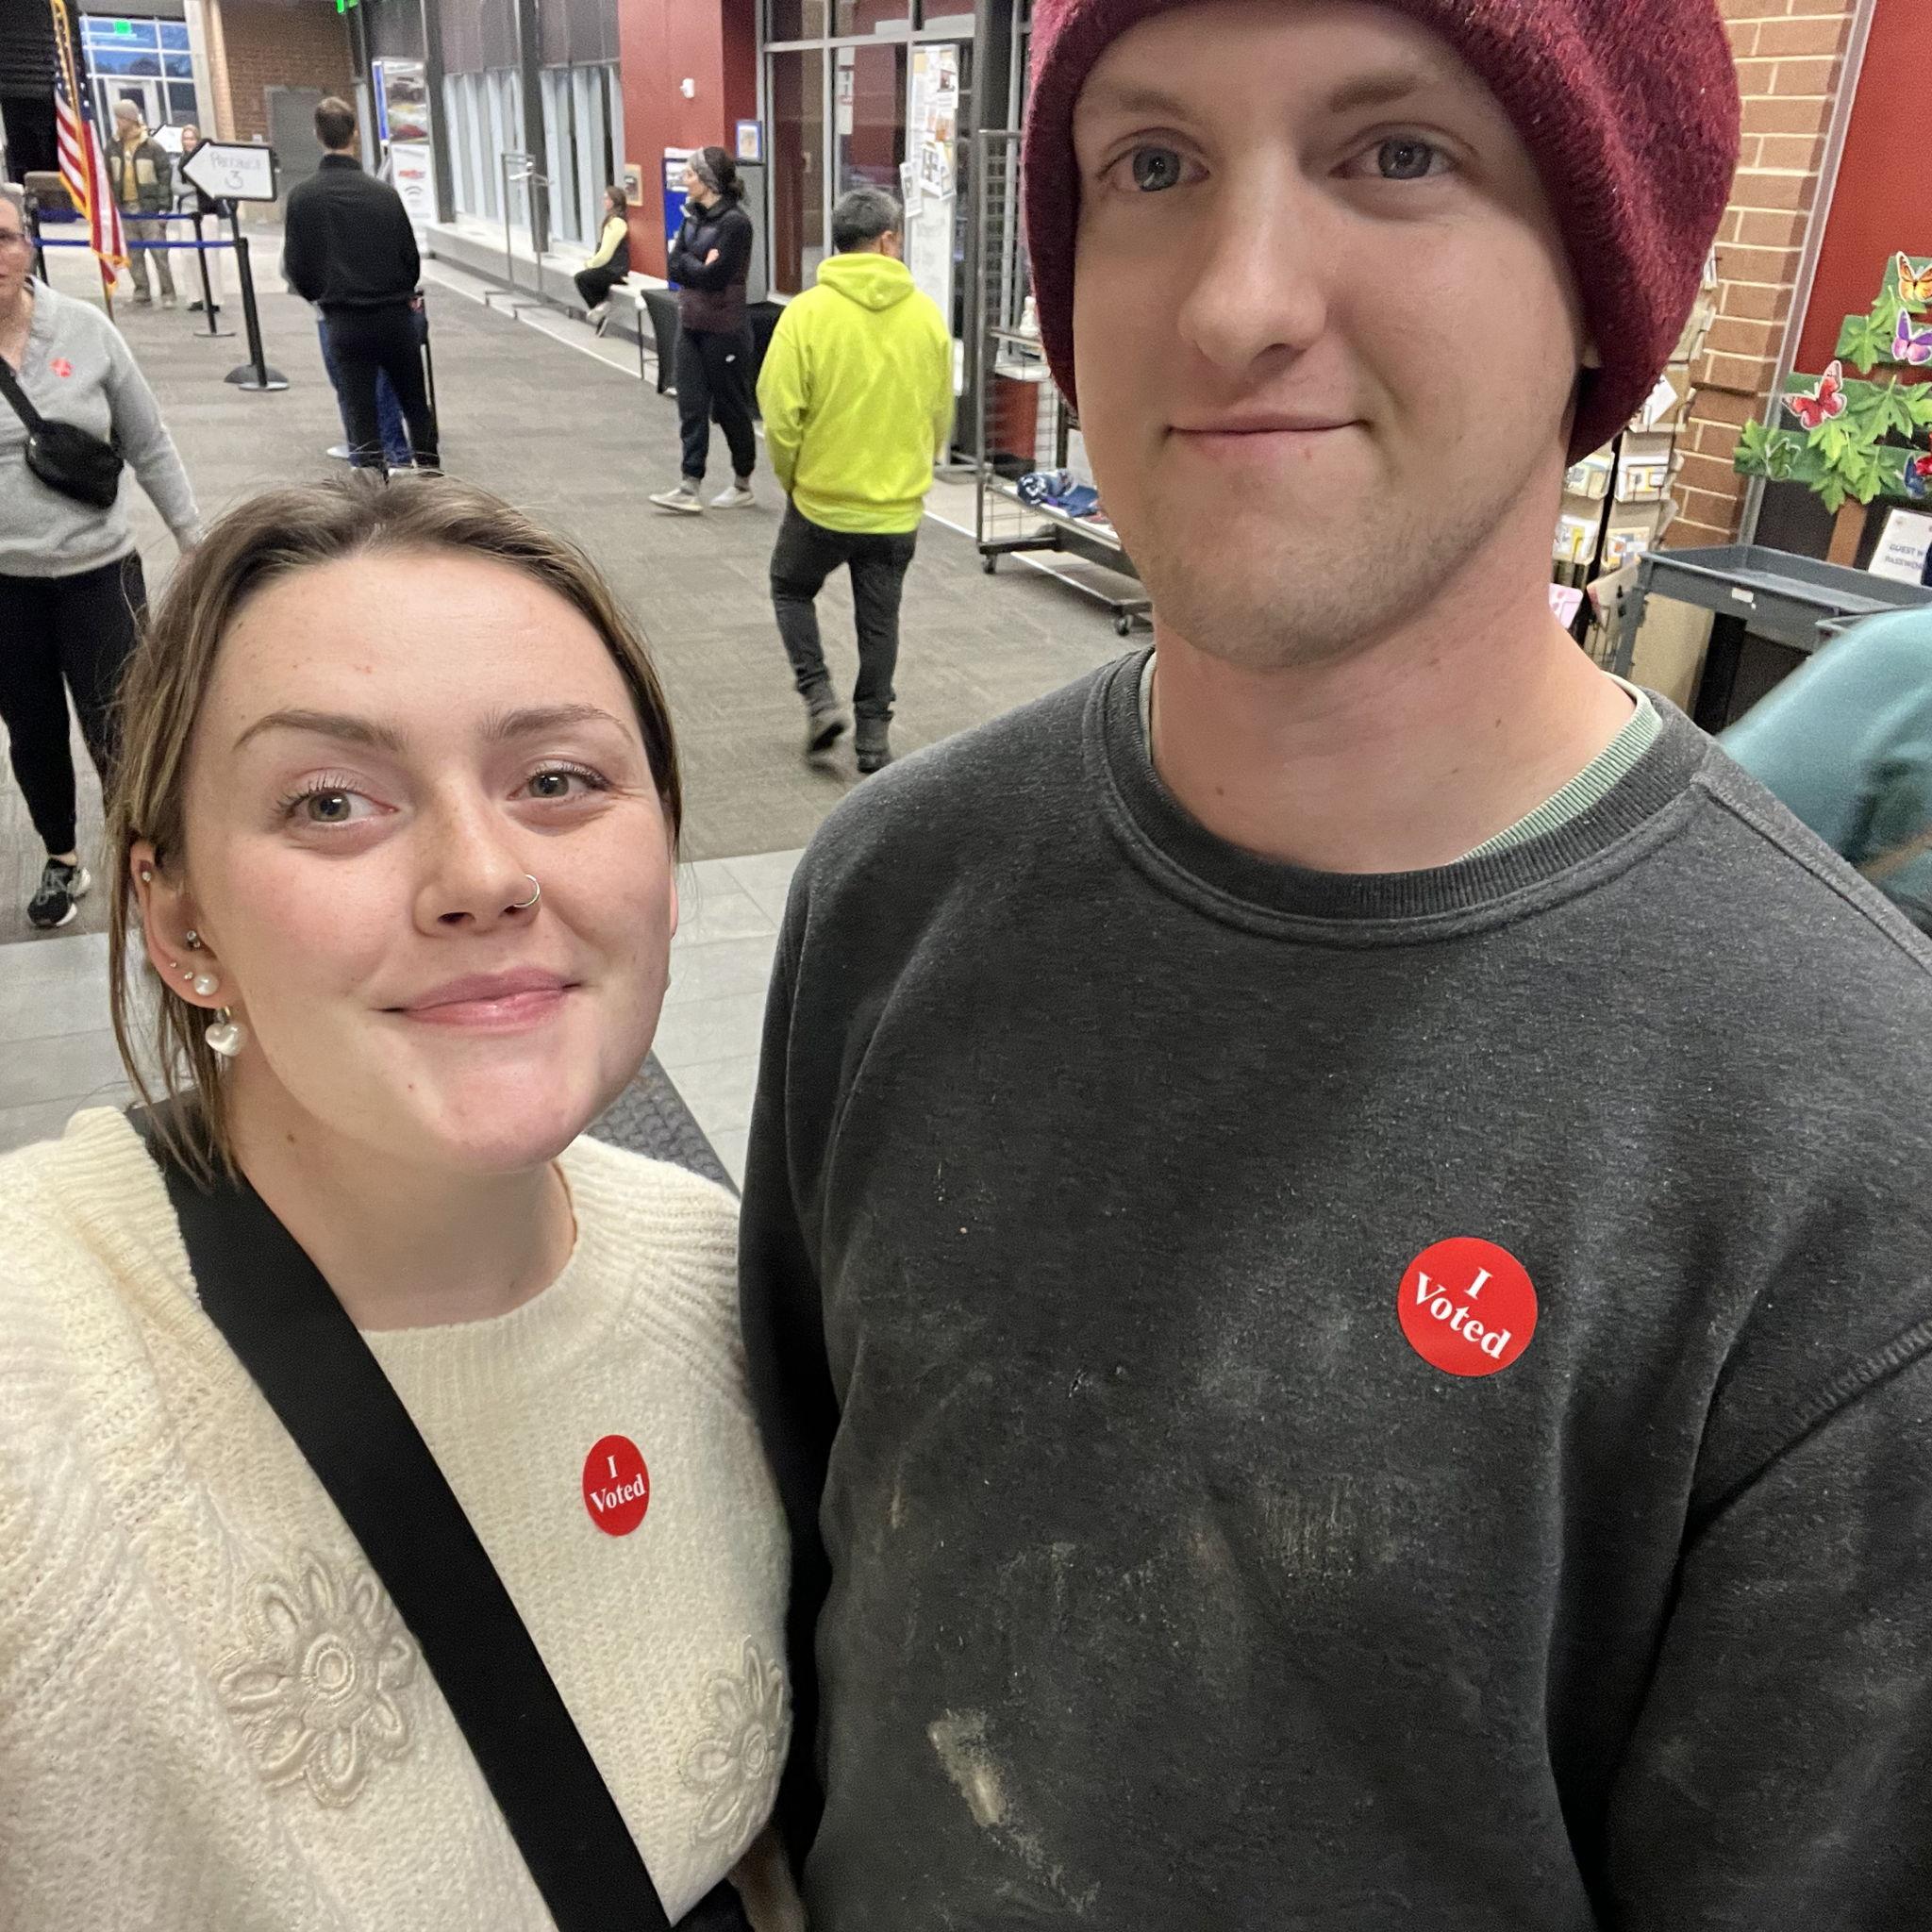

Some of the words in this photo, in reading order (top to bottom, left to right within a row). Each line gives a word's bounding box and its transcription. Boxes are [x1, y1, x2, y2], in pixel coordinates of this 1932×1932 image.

[225, 171, 244, 190] 3
[1464, 1266, 1493, 1300] I
[1416, 1271, 1512, 1359] Voted
[607, 1455, 618, 1479] I
[590, 1474, 646, 1513] Voted
